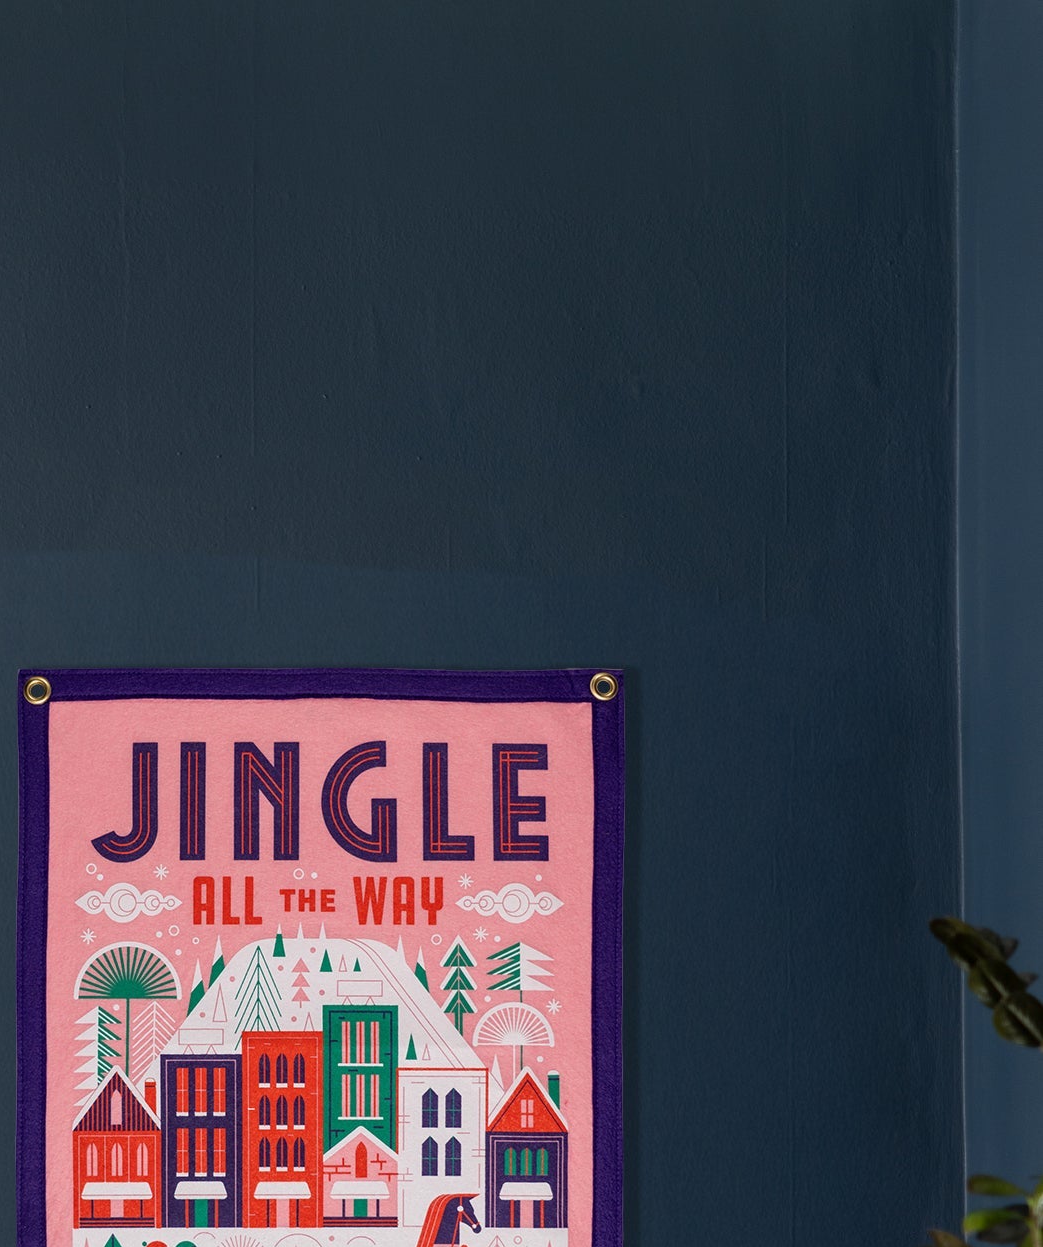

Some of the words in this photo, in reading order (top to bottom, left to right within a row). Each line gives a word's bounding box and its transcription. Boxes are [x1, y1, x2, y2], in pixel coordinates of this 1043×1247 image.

[90, 740, 550, 863] JINGLE
[192, 876, 263, 925] ALL
[279, 888, 336, 913] THE
[353, 876, 445, 926] WAY
